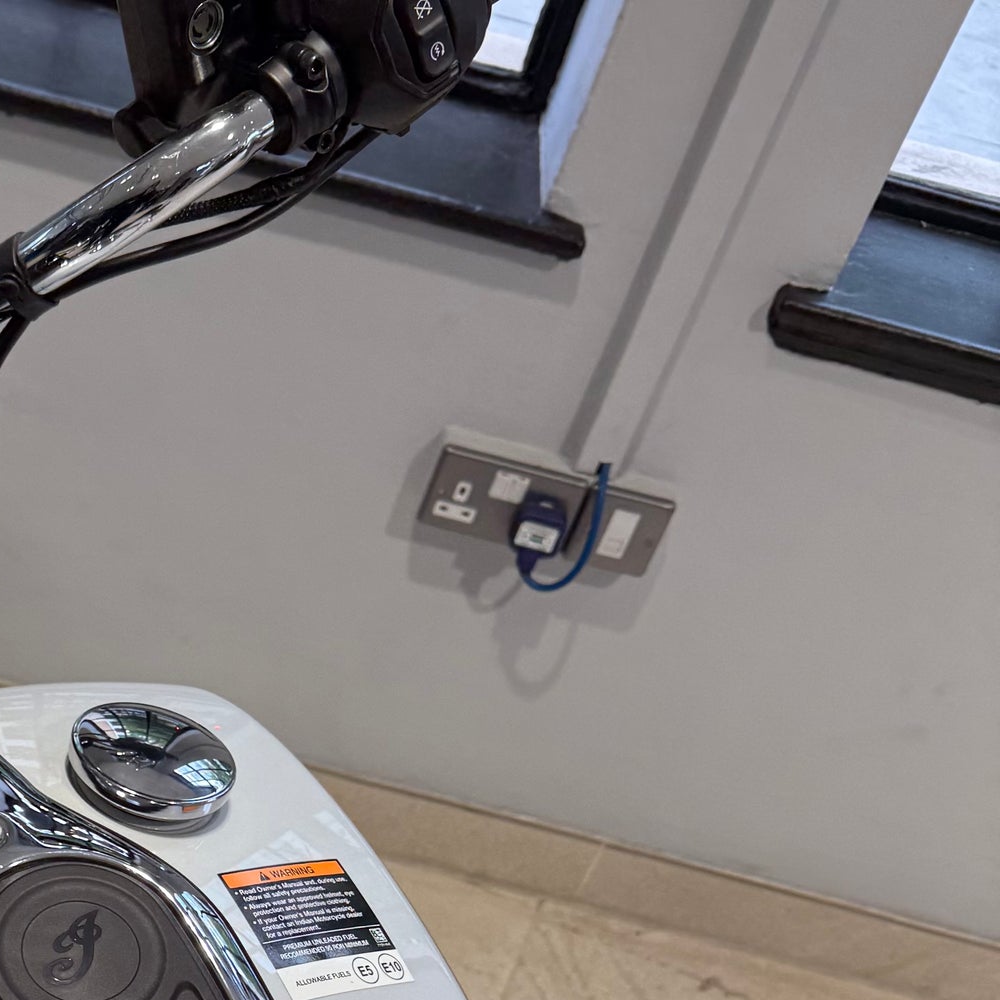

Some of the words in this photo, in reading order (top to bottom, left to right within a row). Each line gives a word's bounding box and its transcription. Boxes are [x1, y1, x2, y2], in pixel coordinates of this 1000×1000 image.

[270, 866, 315, 878] WARNING
[311, 935, 342, 945] UNLEADED
[357, 965, 374, 977] E5
[381, 961, 402, 973] E10
[296, 974, 332, 987] ALLOWABLE
[331, 970, 351, 979] FUELS
